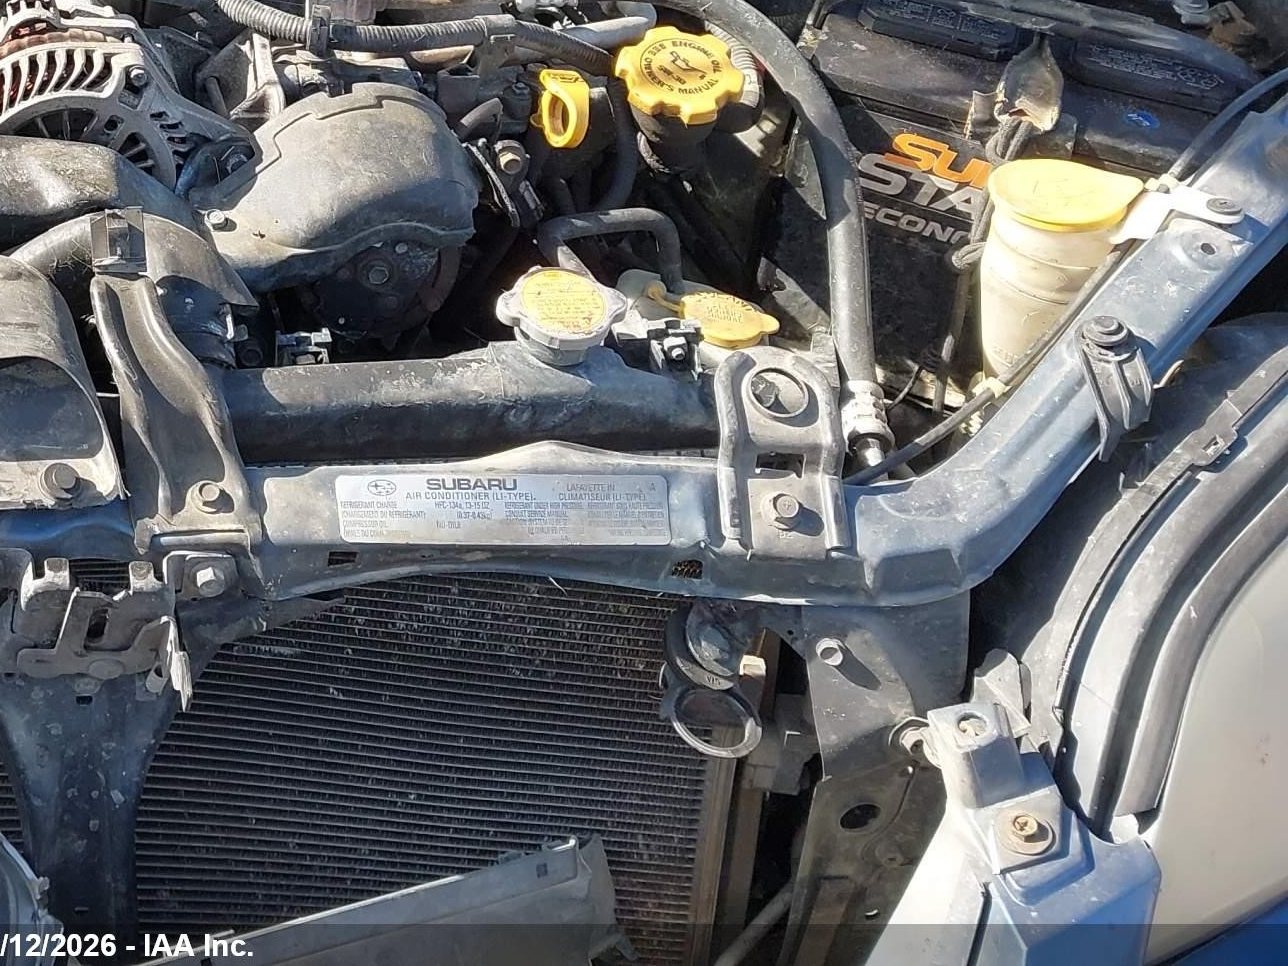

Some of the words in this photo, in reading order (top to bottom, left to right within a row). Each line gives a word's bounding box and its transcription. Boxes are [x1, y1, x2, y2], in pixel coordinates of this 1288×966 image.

[647, 42, 666, 56] SEE
[672, 40, 714, 59] ENGINE
[711, 59, 723, 73] OIL
[643, 57, 674, 92] OWNER'S
[678, 78, 719, 95] MANUAL
[426, 478, 518, 491] SUBARU
[405, 492, 422, 500] AIR
[424, 491, 490, 501] CONDITIONER
[558, 492, 612, 502] CLIMATISEUR
